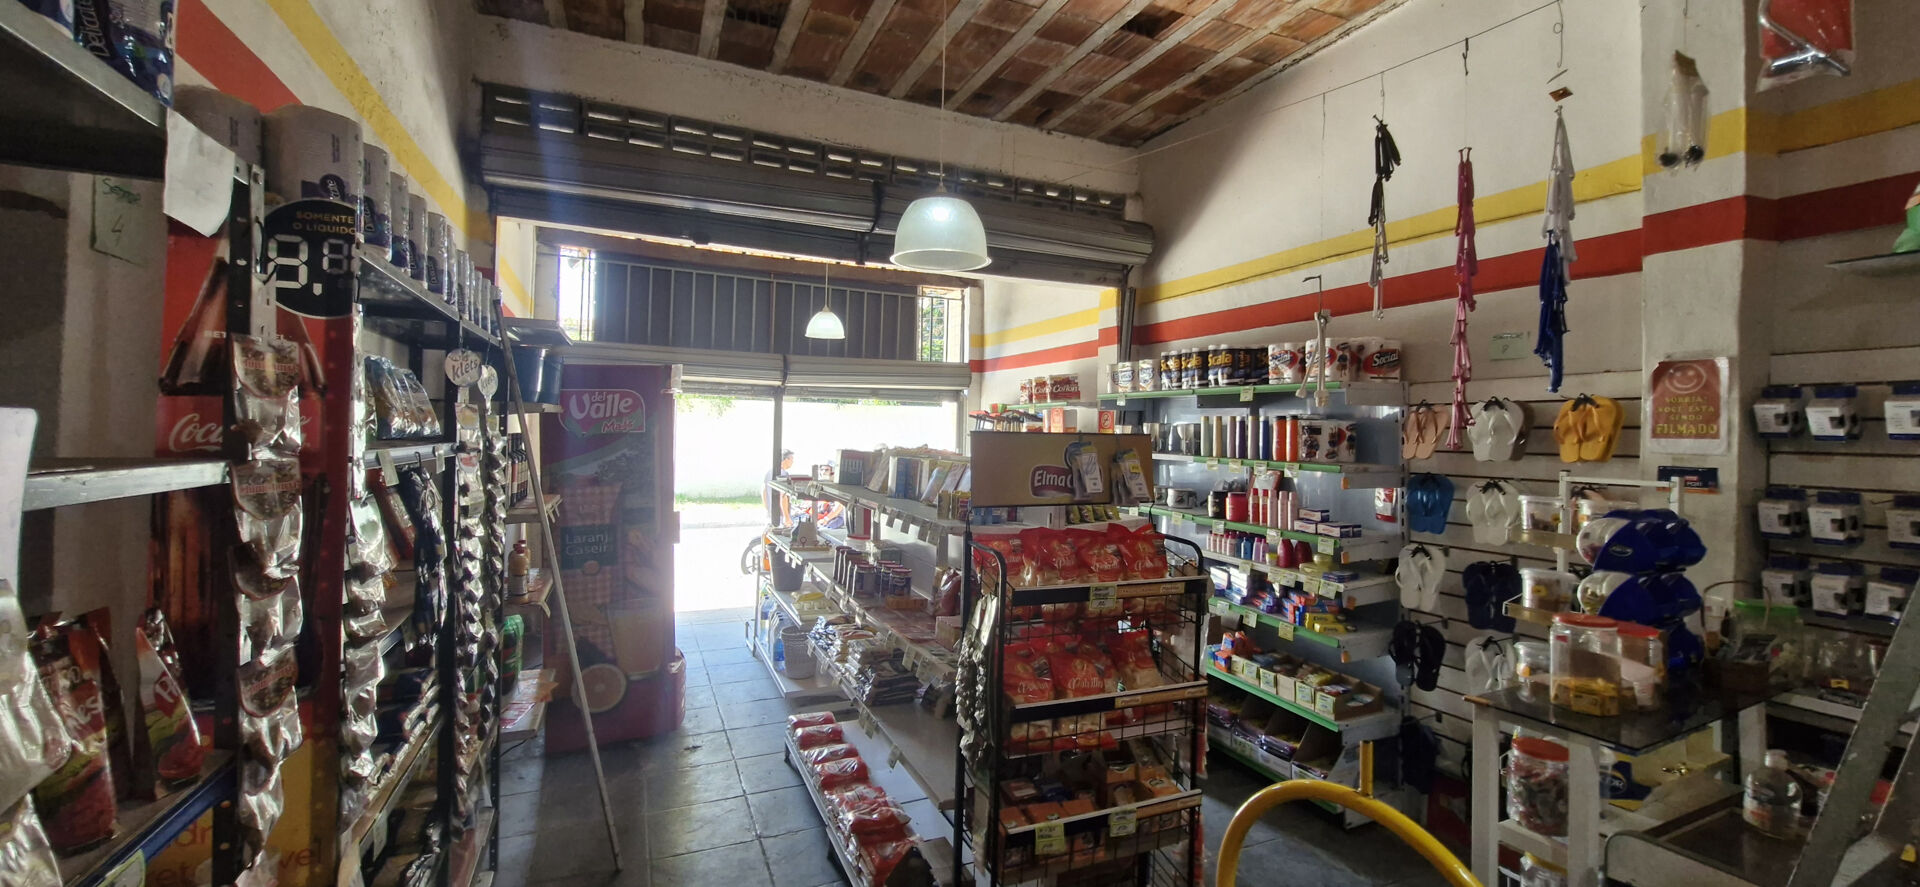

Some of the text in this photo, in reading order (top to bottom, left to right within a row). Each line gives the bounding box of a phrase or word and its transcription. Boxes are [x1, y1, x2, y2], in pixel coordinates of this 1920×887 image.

[295, 210, 355, 224] SOMENTE
[292, 223, 302, 231] O
[1208, 351, 1232, 367] Scala
[1371, 348, 1399, 367] Social
[591, 391, 606, 402] del
[569, 392, 633, 420] Valle
[1656, 423, 1718, 435] FILMADO
